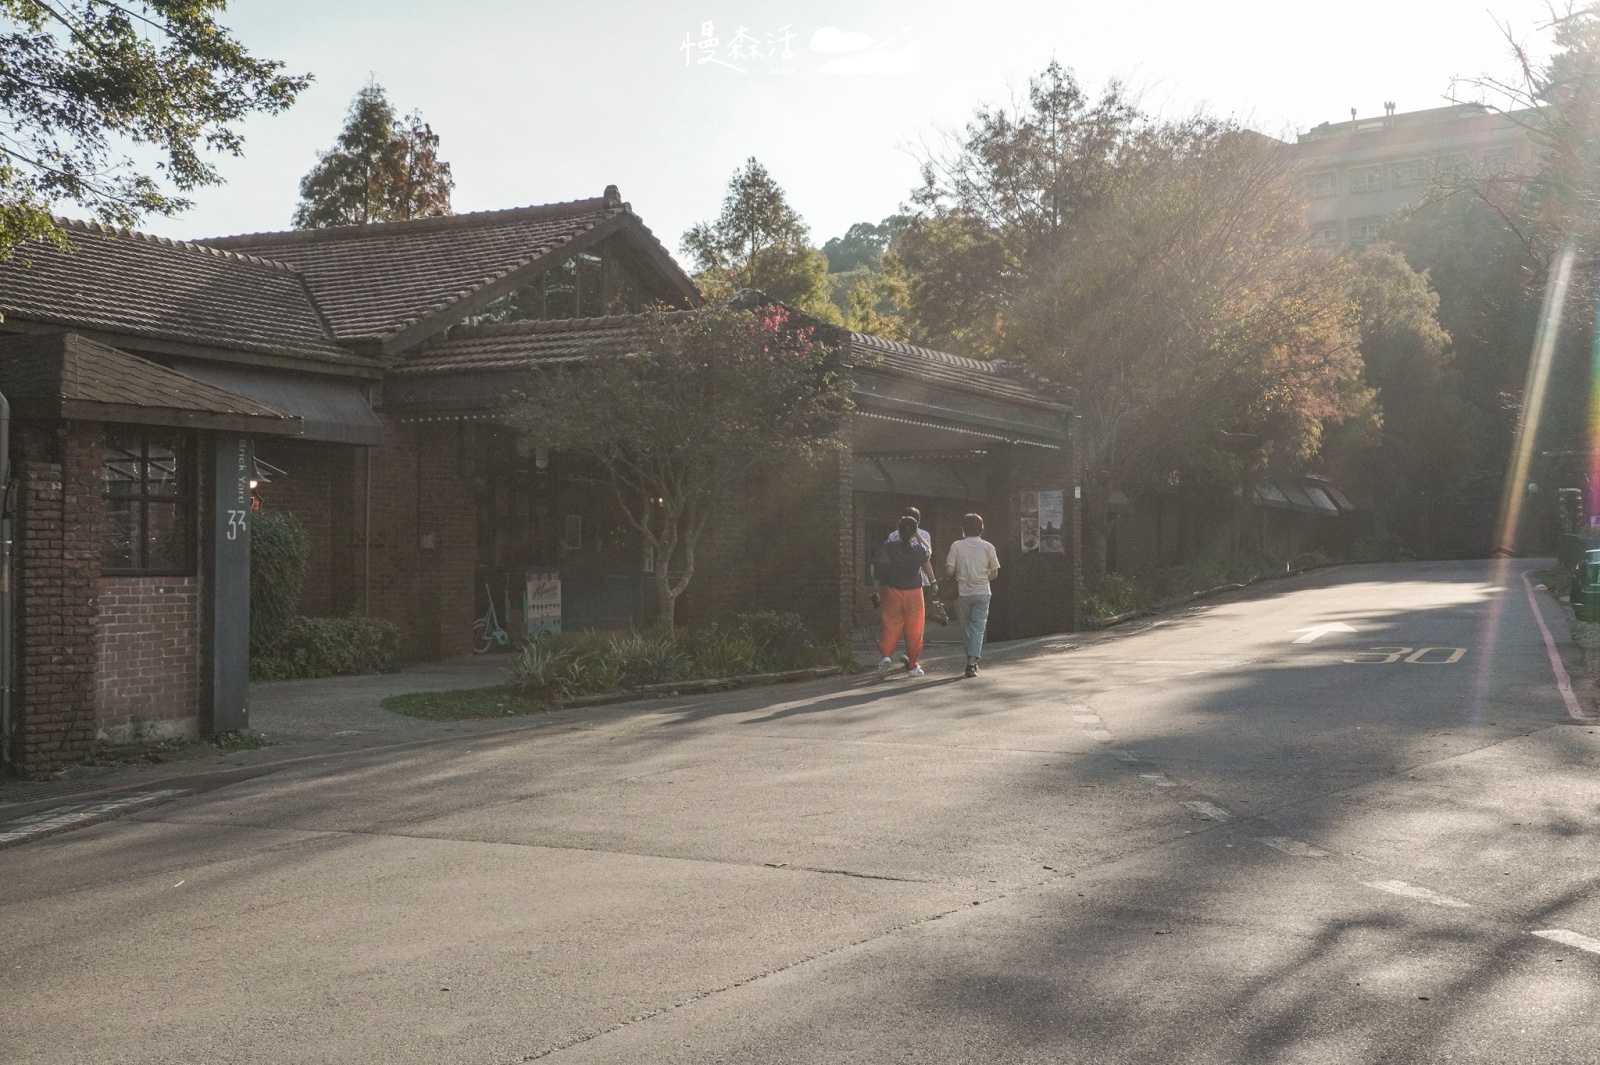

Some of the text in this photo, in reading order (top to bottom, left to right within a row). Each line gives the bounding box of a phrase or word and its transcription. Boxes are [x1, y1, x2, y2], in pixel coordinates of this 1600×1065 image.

[238, 439, 246, 504] Brick Yard
[227, 510, 246, 540] 33
[1343, 646, 1468, 664] 30
